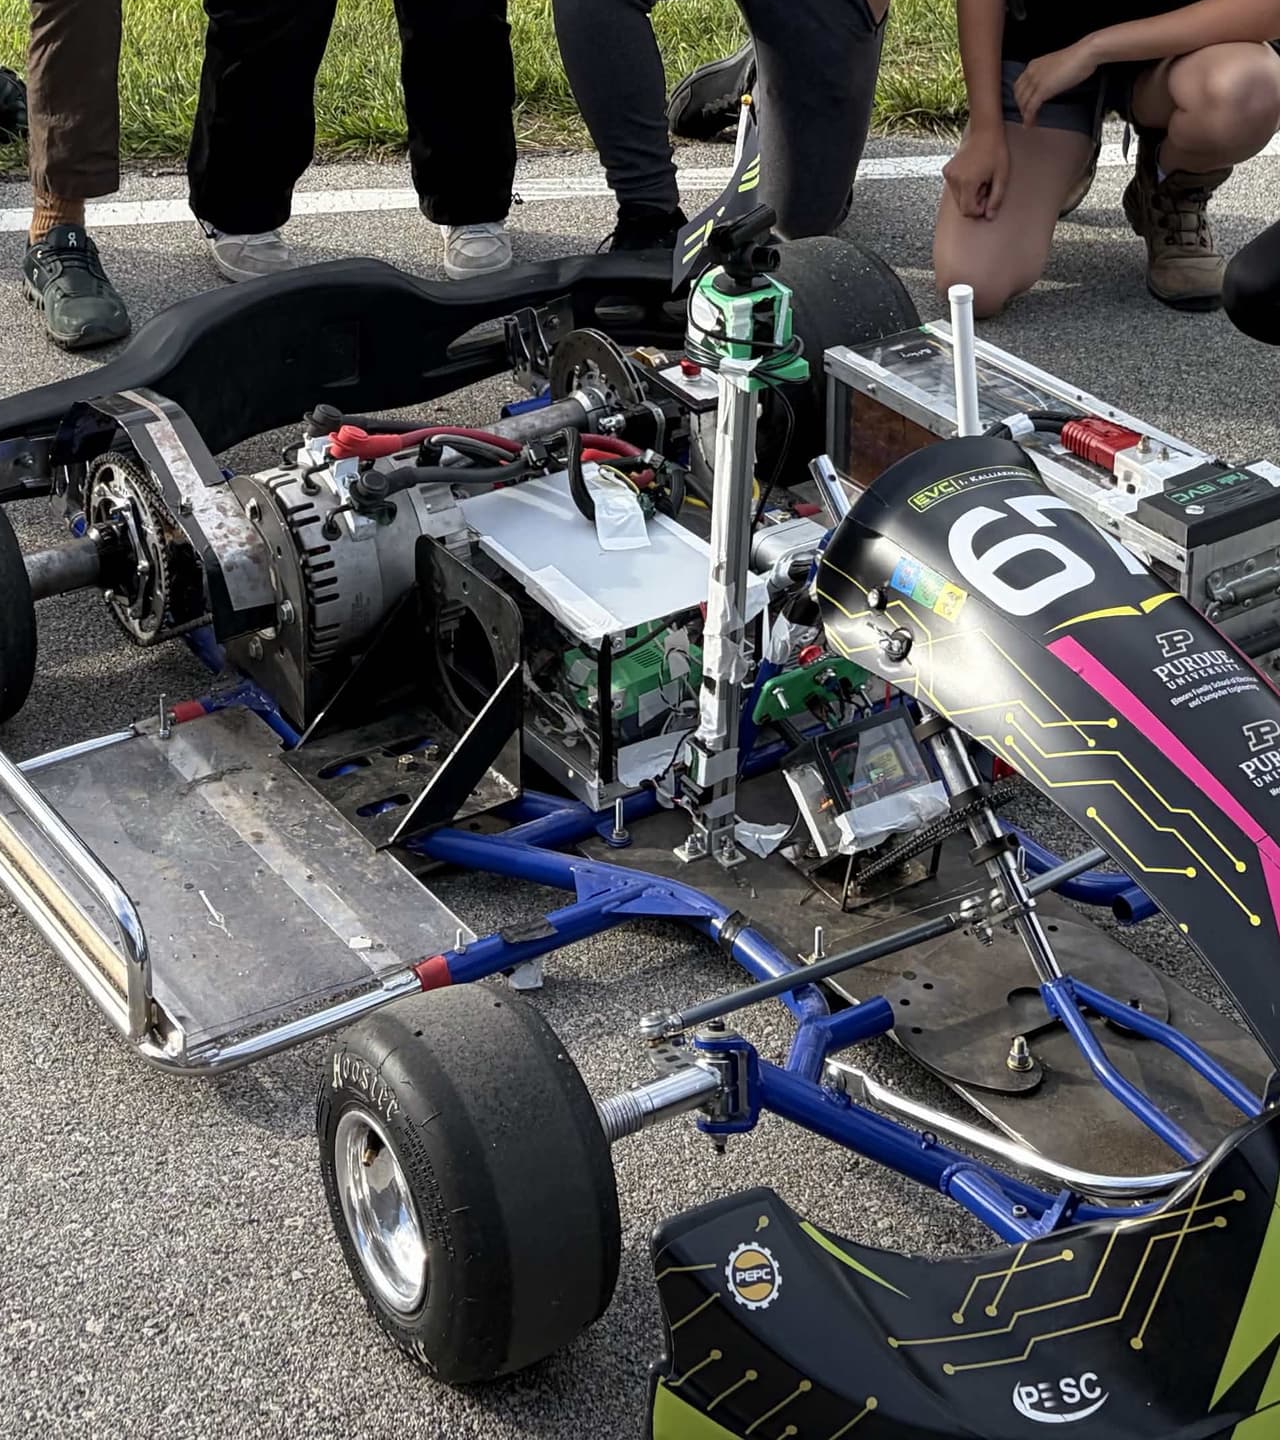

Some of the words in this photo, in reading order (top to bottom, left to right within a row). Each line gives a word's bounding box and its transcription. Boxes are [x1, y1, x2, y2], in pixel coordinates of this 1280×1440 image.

[913, 481, 956, 506] EVC
[948, 495, 1149, 617] 67
[1152, 649, 1234, 683] PURDUE
[1166, 663, 1241, 690] UNIVERSITY
[735, 1268, 772, 1283] PEPC
